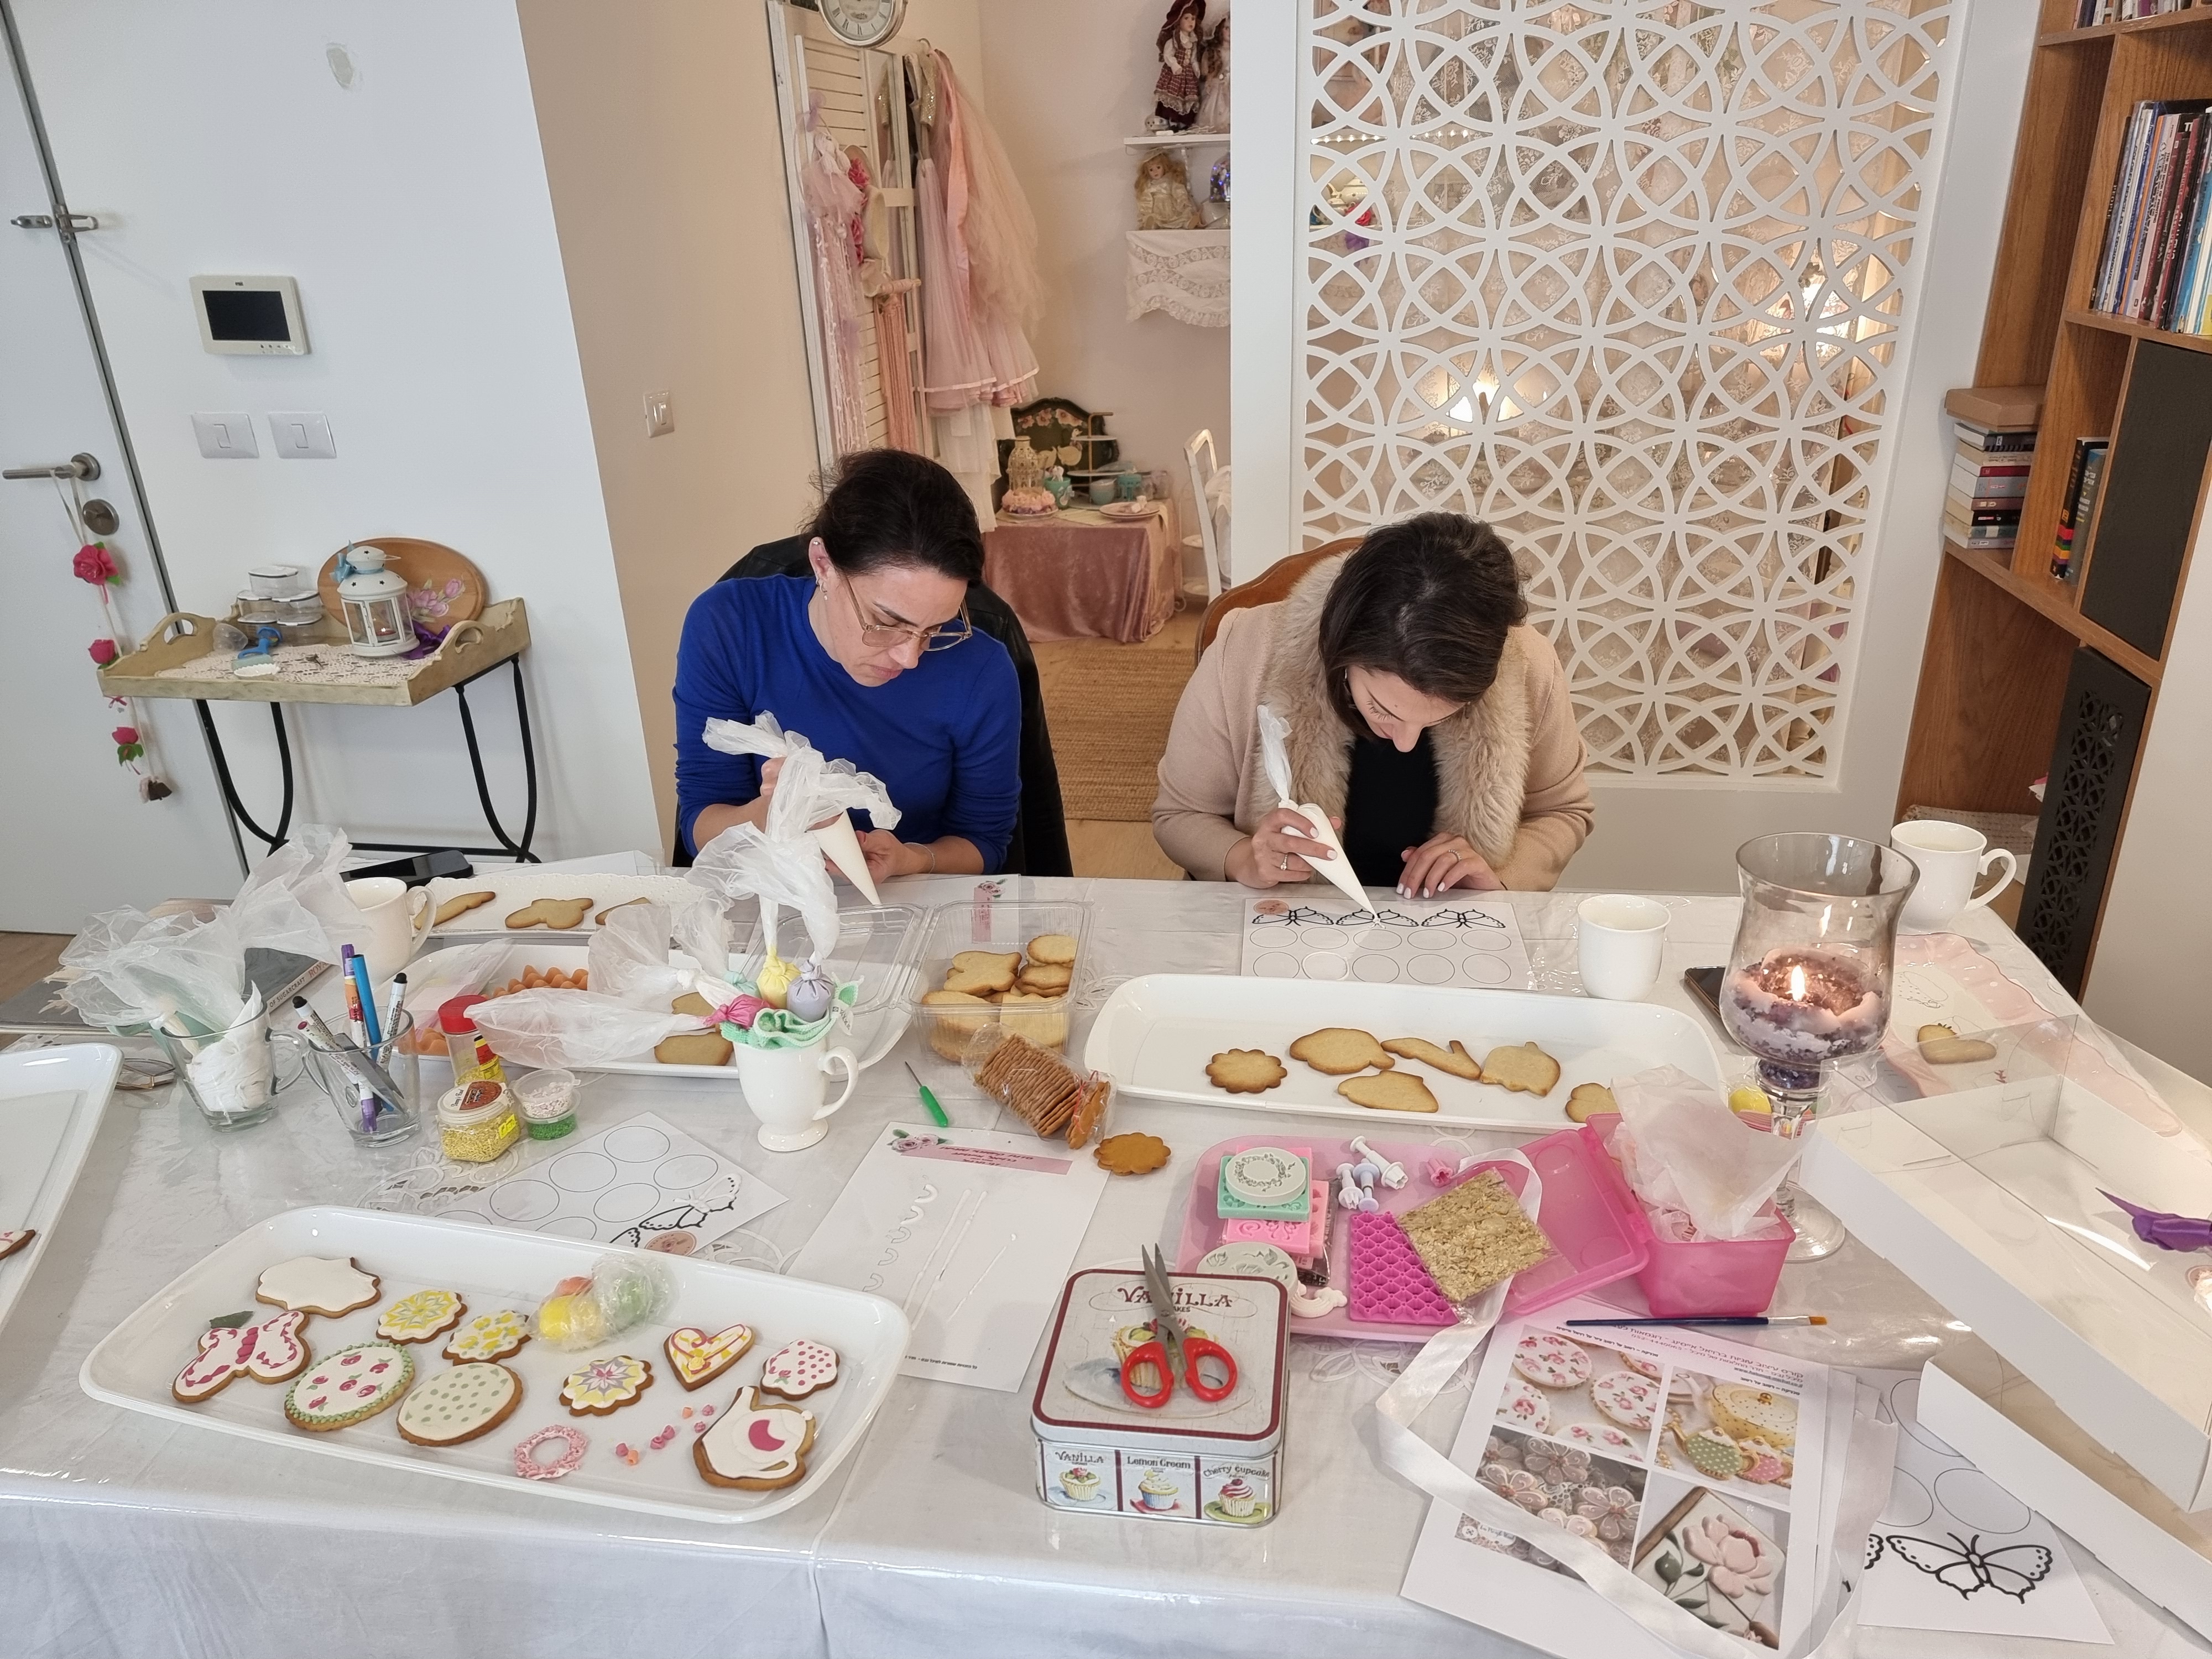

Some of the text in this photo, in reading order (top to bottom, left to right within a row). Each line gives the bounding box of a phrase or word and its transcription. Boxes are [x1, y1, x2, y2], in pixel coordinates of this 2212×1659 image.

[277, 977, 305, 1001] SUGARCRAFT
[308, 962, 328, 978] ROYA
[1117, 1286, 1233, 1307] VAILLA
[1671, 1339, 1697, 1349] אייסינג
[1699, 1345, 1727, 1358] ברויאל
[1730, 1355, 1754, 1364] עוגיות
[1756, 1362, 1778, 1371] עיצוב
[1782, 1369, 1803, 1378] קורס
[1127, 1456, 1158, 1467] Lemon
[1160, 1459, 1191, 1469] Cream
